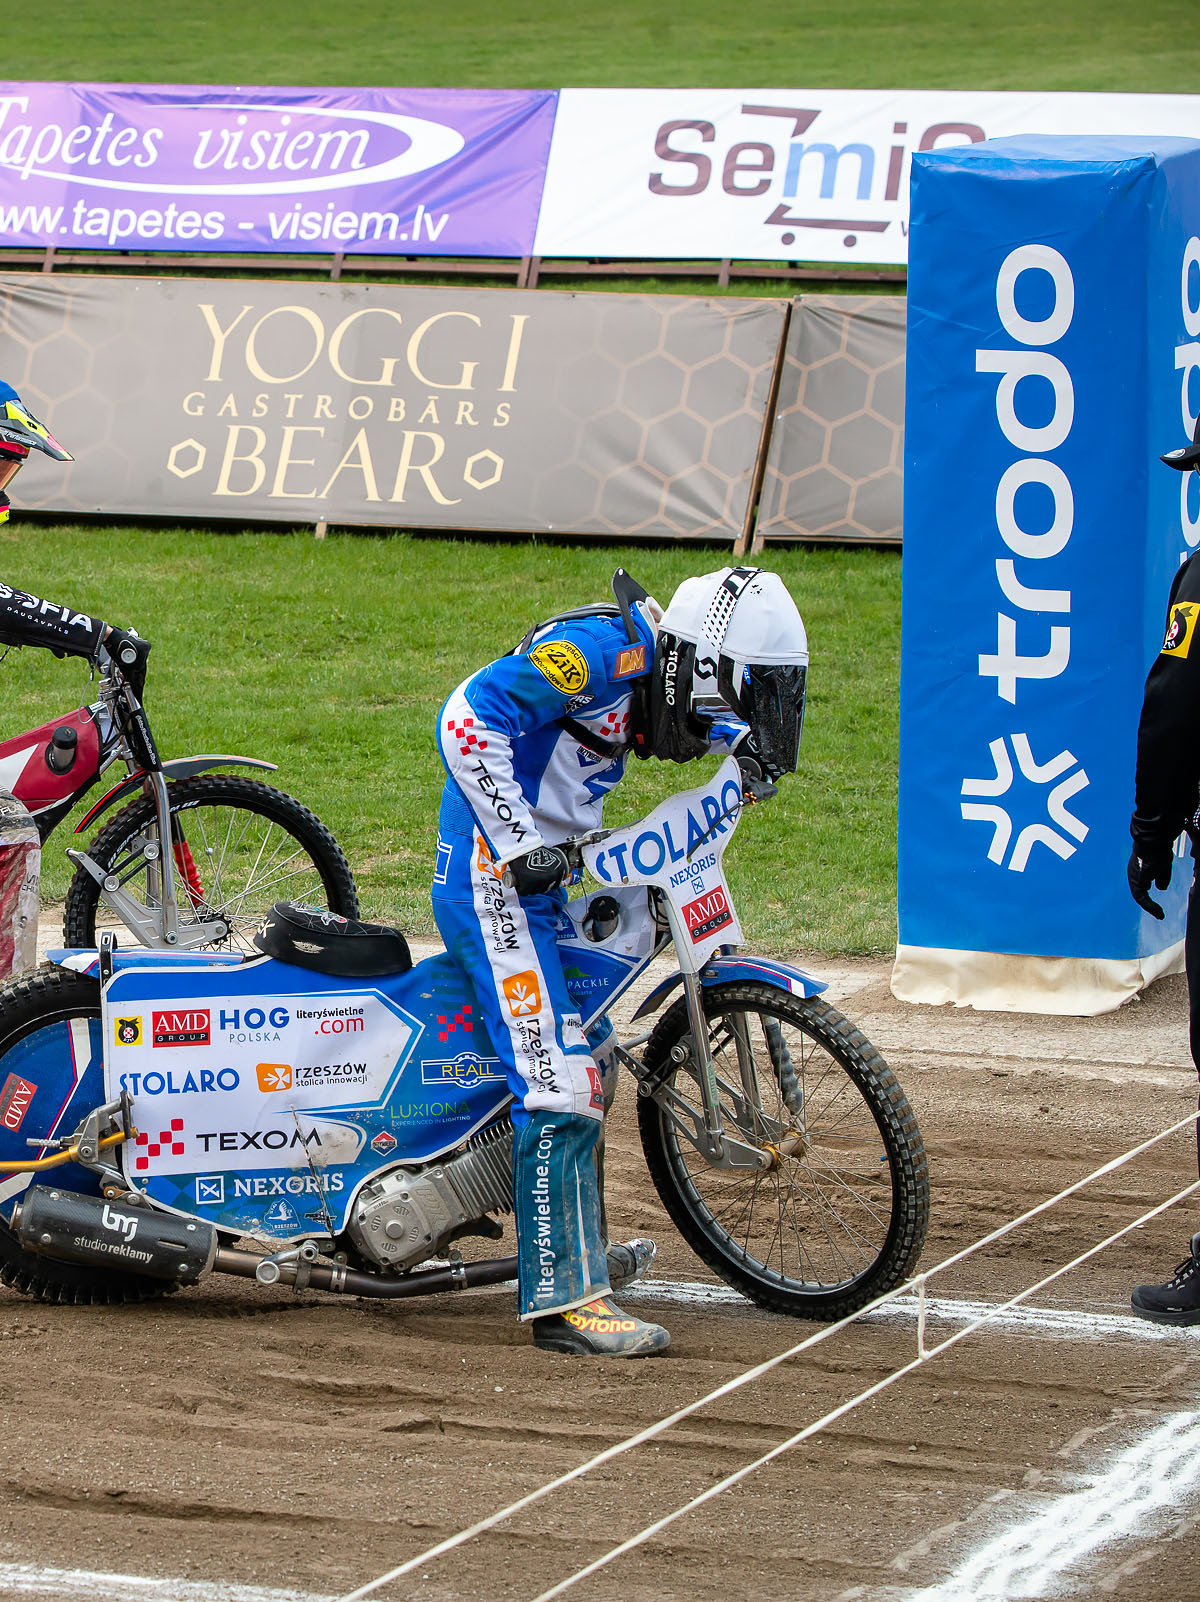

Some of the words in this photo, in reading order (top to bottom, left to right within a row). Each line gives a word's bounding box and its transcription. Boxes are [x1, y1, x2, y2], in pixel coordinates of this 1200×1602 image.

[193, 120, 373, 171] visiem
[268, 202, 449, 242] visiem.lv
[197, 303, 530, 393] YOGGI
[182, 391, 511, 427] GASTROBĀRS
[212, 425, 463, 506] BEAR
[975, 243, 1075, 706] trodo
[6, 606, 69, 635] DAUGAVPILS
[664, 650, 678, 706] STOLARO
[471, 759, 530, 844] TEXOM
[595, 779, 741, 882] STOLARO
[670, 852, 717, 888] NEXORIS
[688, 891, 726, 928] AMD
[693, 912, 730, 936] GROUP
[567, 977, 610, 990] PACKIE
[155, 1012, 209, 1032] AMD
[219, 1007, 290, 1030] HOG
[296, 1006, 364, 1020] literyświetlne
[314, 1017, 364, 1035] .com
[157, 1033, 206, 1042] GROUP
[229, 1032, 281, 1043] POLSKA
[526, 1018, 561, 1094] rzeszów
[119, 1068, 240, 1096] STOLARO
[295, 1062, 367, 1079] rzeszów
[295, 1078, 324, 1087] stolica
[441, 1063, 495, 1077] REALL
[4, 1081, 34, 1129] AMD
[390, 1101, 471, 1119] LUXIONA
[442, 1115, 471, 1123] LIGHTING
[195, 1127, 323, 1152] TEXOM
[234, 1173, 345, 1197] NEXORIS
